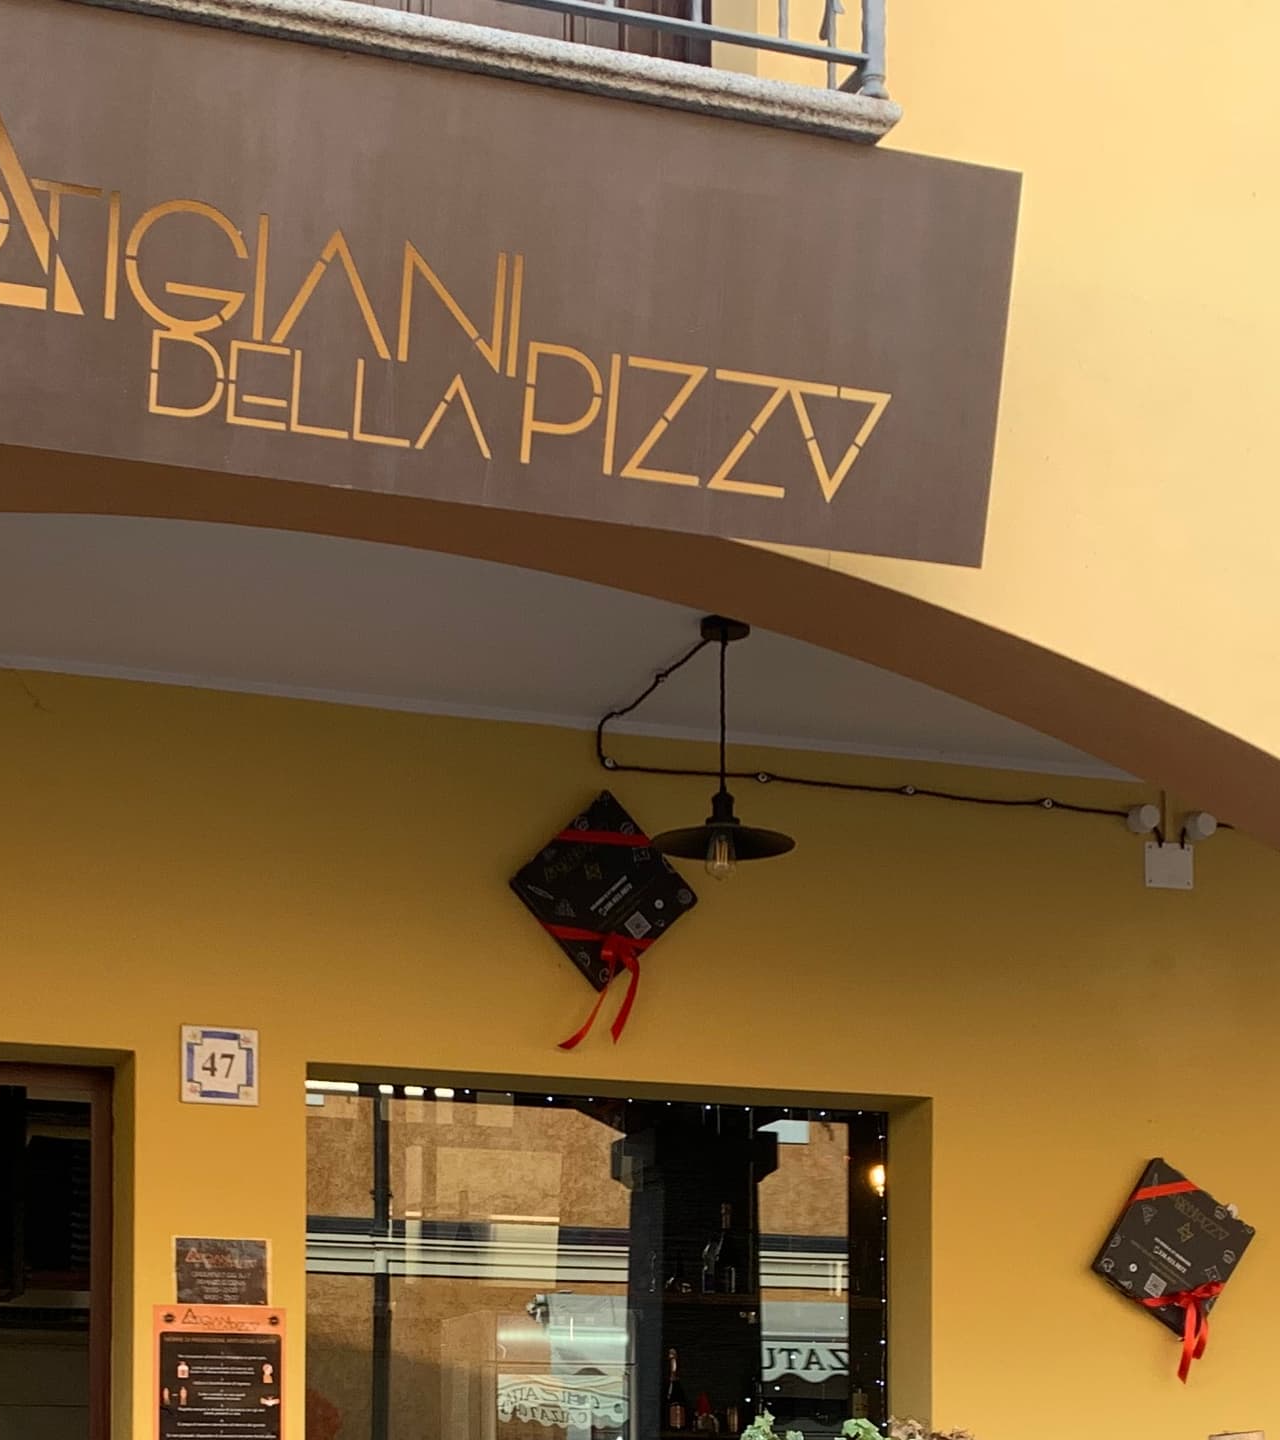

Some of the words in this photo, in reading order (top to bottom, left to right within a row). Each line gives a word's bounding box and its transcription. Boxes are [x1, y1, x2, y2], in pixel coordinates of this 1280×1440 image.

[147, 330, 491, 460] DELLA
[520, 341, 892, 504] PIZZA
[201, 1051, 236, 1080] 47
